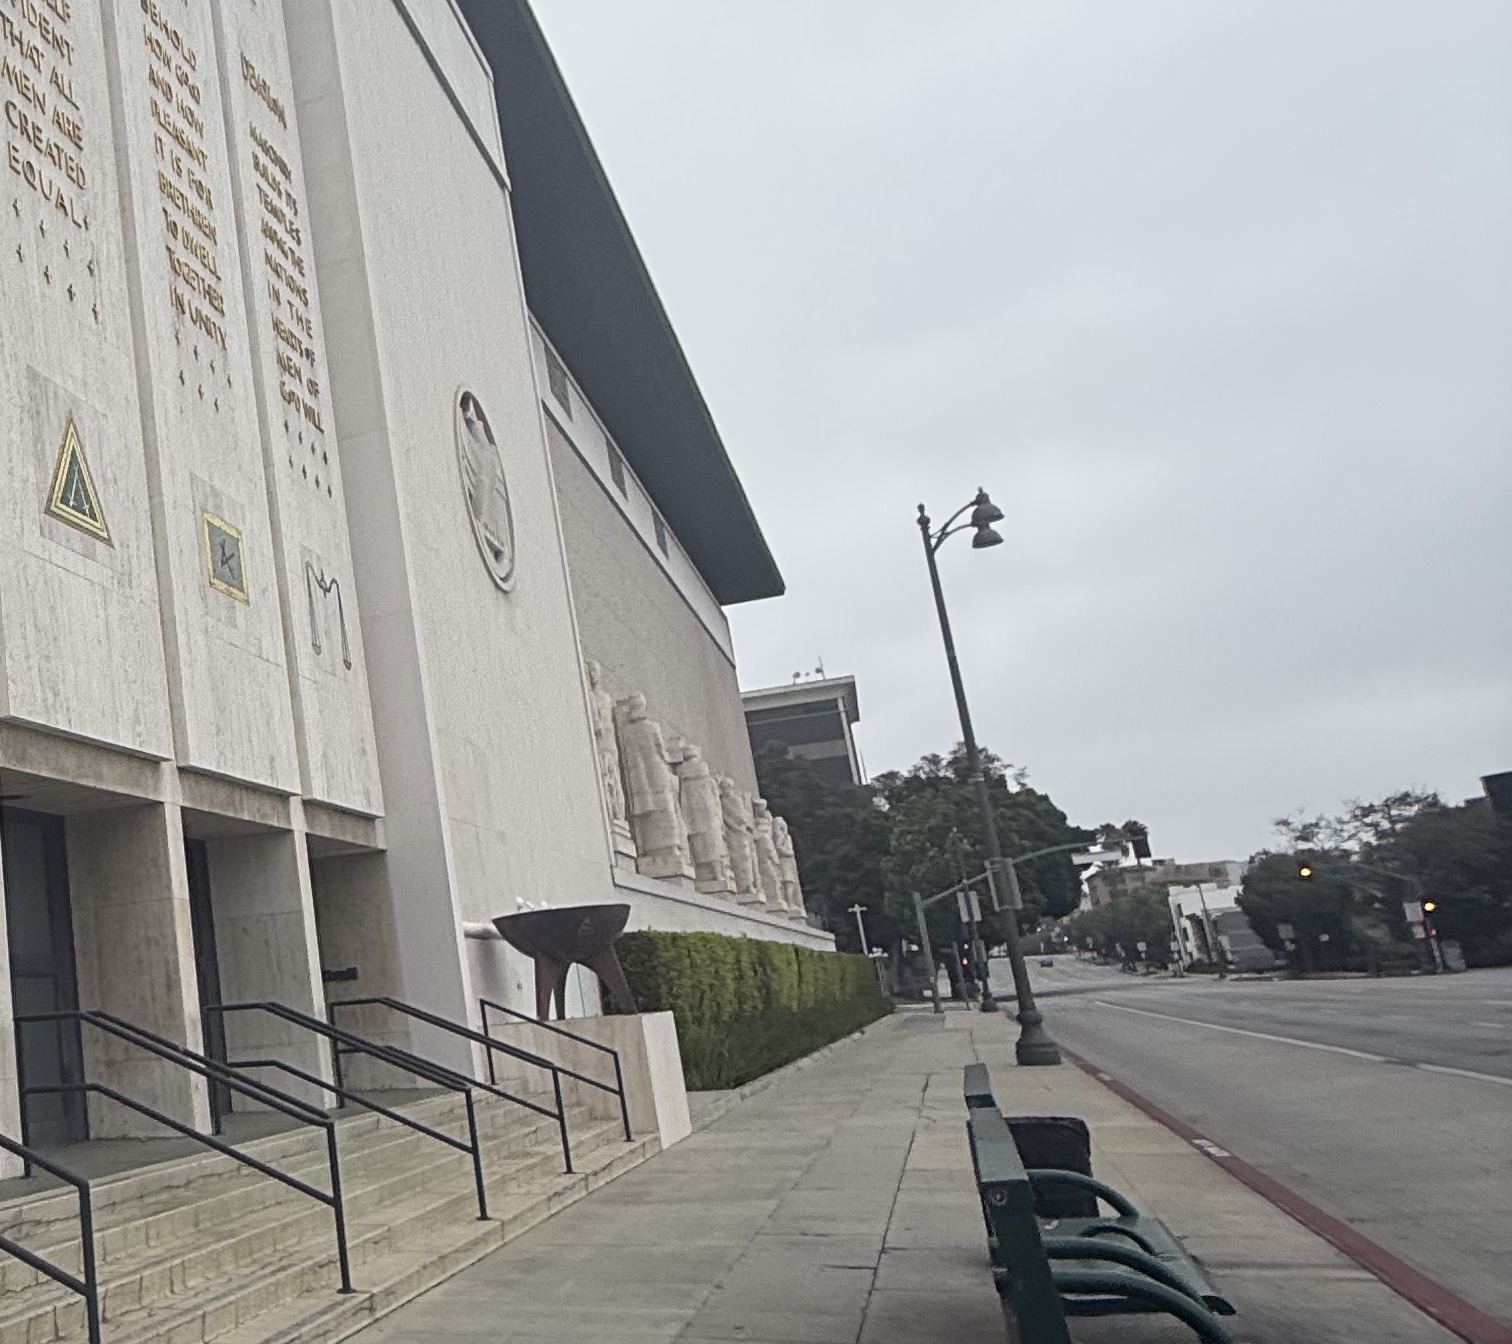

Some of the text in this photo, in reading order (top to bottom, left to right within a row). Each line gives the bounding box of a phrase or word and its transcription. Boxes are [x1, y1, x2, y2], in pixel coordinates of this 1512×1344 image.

[143, 24, 172, 72] HOW
[1, 56, 83, 152] MEN ARE
[49, 66, 80, 111] ALL
[148, 63, 204, 138] AND HOW
[5, 100, 86, 190] CREATED
[151, 97, 208, 172] PLEASANT
[7, 141, 82, 229] EQUAL
[154, 132, 214, 210] IT IS FOR
[158, 169, 217, 245] BRETHREN
[256, 182, 301, 246] TEMPLES
[166, 244, 225, 317] TOGETHER
[181, 226, 222, 281] DWELL
[264, 247, 308, 307] NATIONS
[288, 246, 305, 277] THE
[169, 284, 228, 351] IN UNITY
[267, 279, 313, 339] IN THE
[276, 351, 319, 398] MEN OF
[304, 347, 315, 369] OF
[301, 397, 324, 434] WILL
